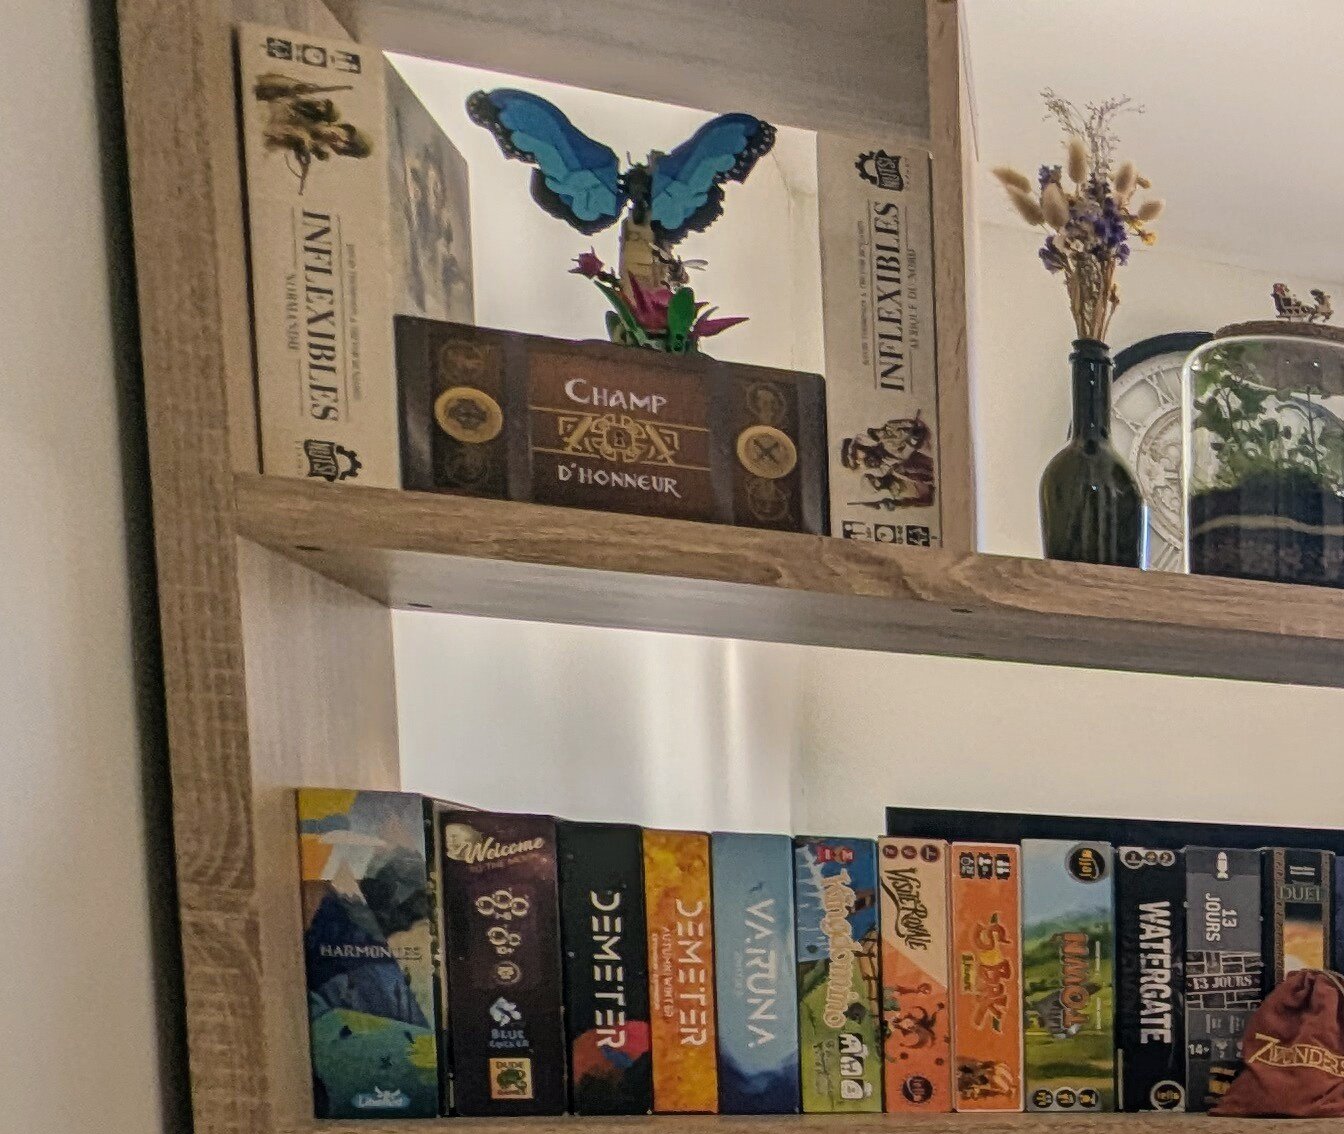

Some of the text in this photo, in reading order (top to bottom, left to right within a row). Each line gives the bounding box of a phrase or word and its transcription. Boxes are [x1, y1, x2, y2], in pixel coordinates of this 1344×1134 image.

[299, 207, 339, 422] INFLEXIBLES
[873, 201, 905, 393] INFLEXIBLES
[564, 376, 669, 416] CHAMP
[556, 460, 684, 500] D'HONNEUR
[464, 836, 545, 866] Welcome
[821, 870, 865, 1029] Kingdomino
[1205, 893, 1222, 943] JOURS
[1220, 909, 1238, 928] 13
[589, 889, 628, 1051] DEMETER
[674, 898, 708, 1048] DEMETER
[1139, 900, 1173, 1044] WATERGATE
[1193, 975, 1253, 991] 13 JOURS
